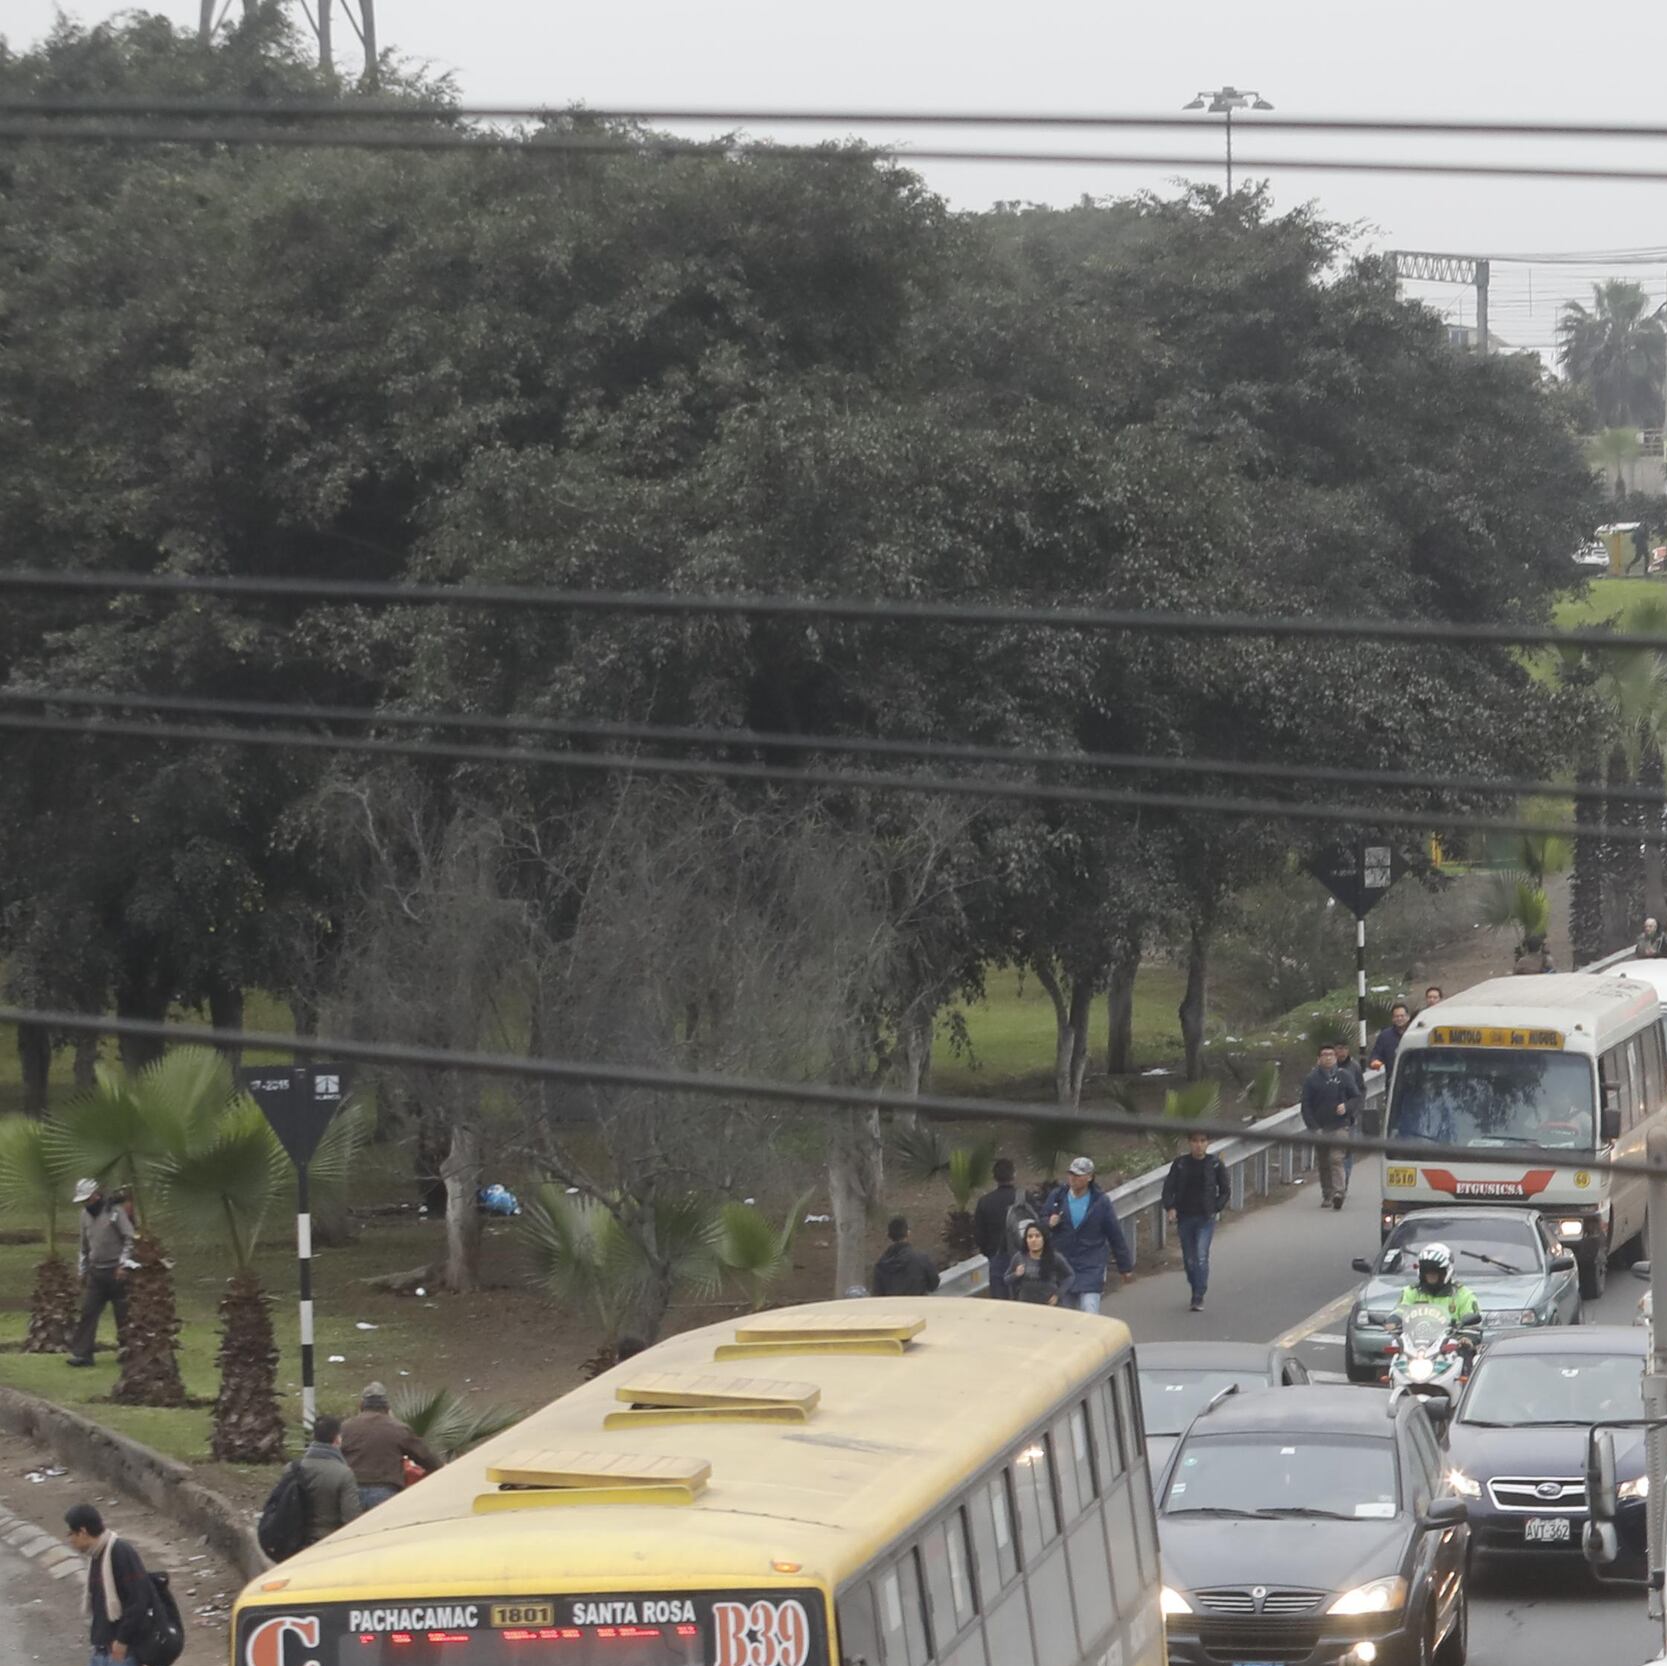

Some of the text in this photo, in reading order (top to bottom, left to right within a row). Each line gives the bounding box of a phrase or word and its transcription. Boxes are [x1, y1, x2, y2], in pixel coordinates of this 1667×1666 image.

[349, 1600, 696, 1632] PACHACAMAC 1801 SANTA ROSA
